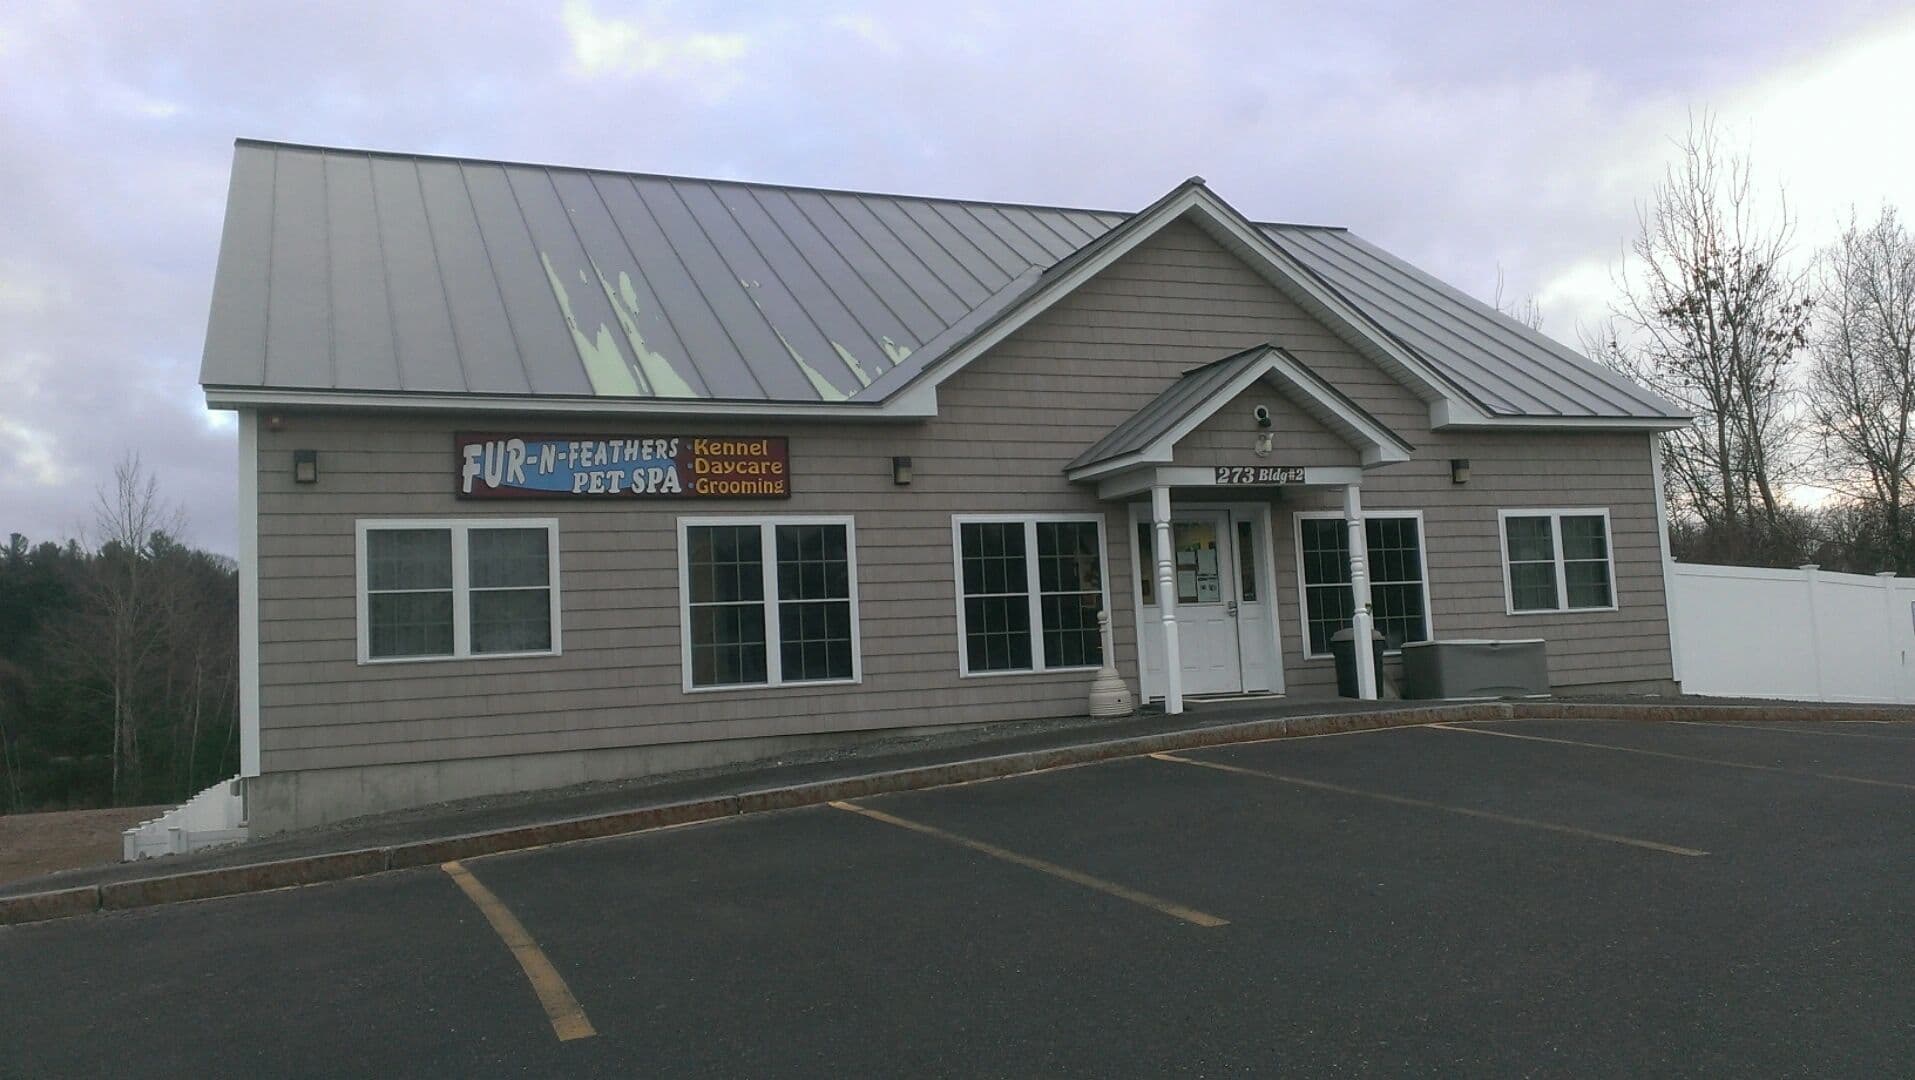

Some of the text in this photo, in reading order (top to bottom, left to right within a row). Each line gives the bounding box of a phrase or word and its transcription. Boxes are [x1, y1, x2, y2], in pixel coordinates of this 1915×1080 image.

[693, 438, 768, 457] Kennel
[462, 438, 680, 493] FUR-N-FEATHERS
[694, 457, 784, 475] Daycare
[571, 467, 682, 494] PET SPA
[1217, 466, 1255, 484] 273
[695, 477, 785, 495] Grooming
